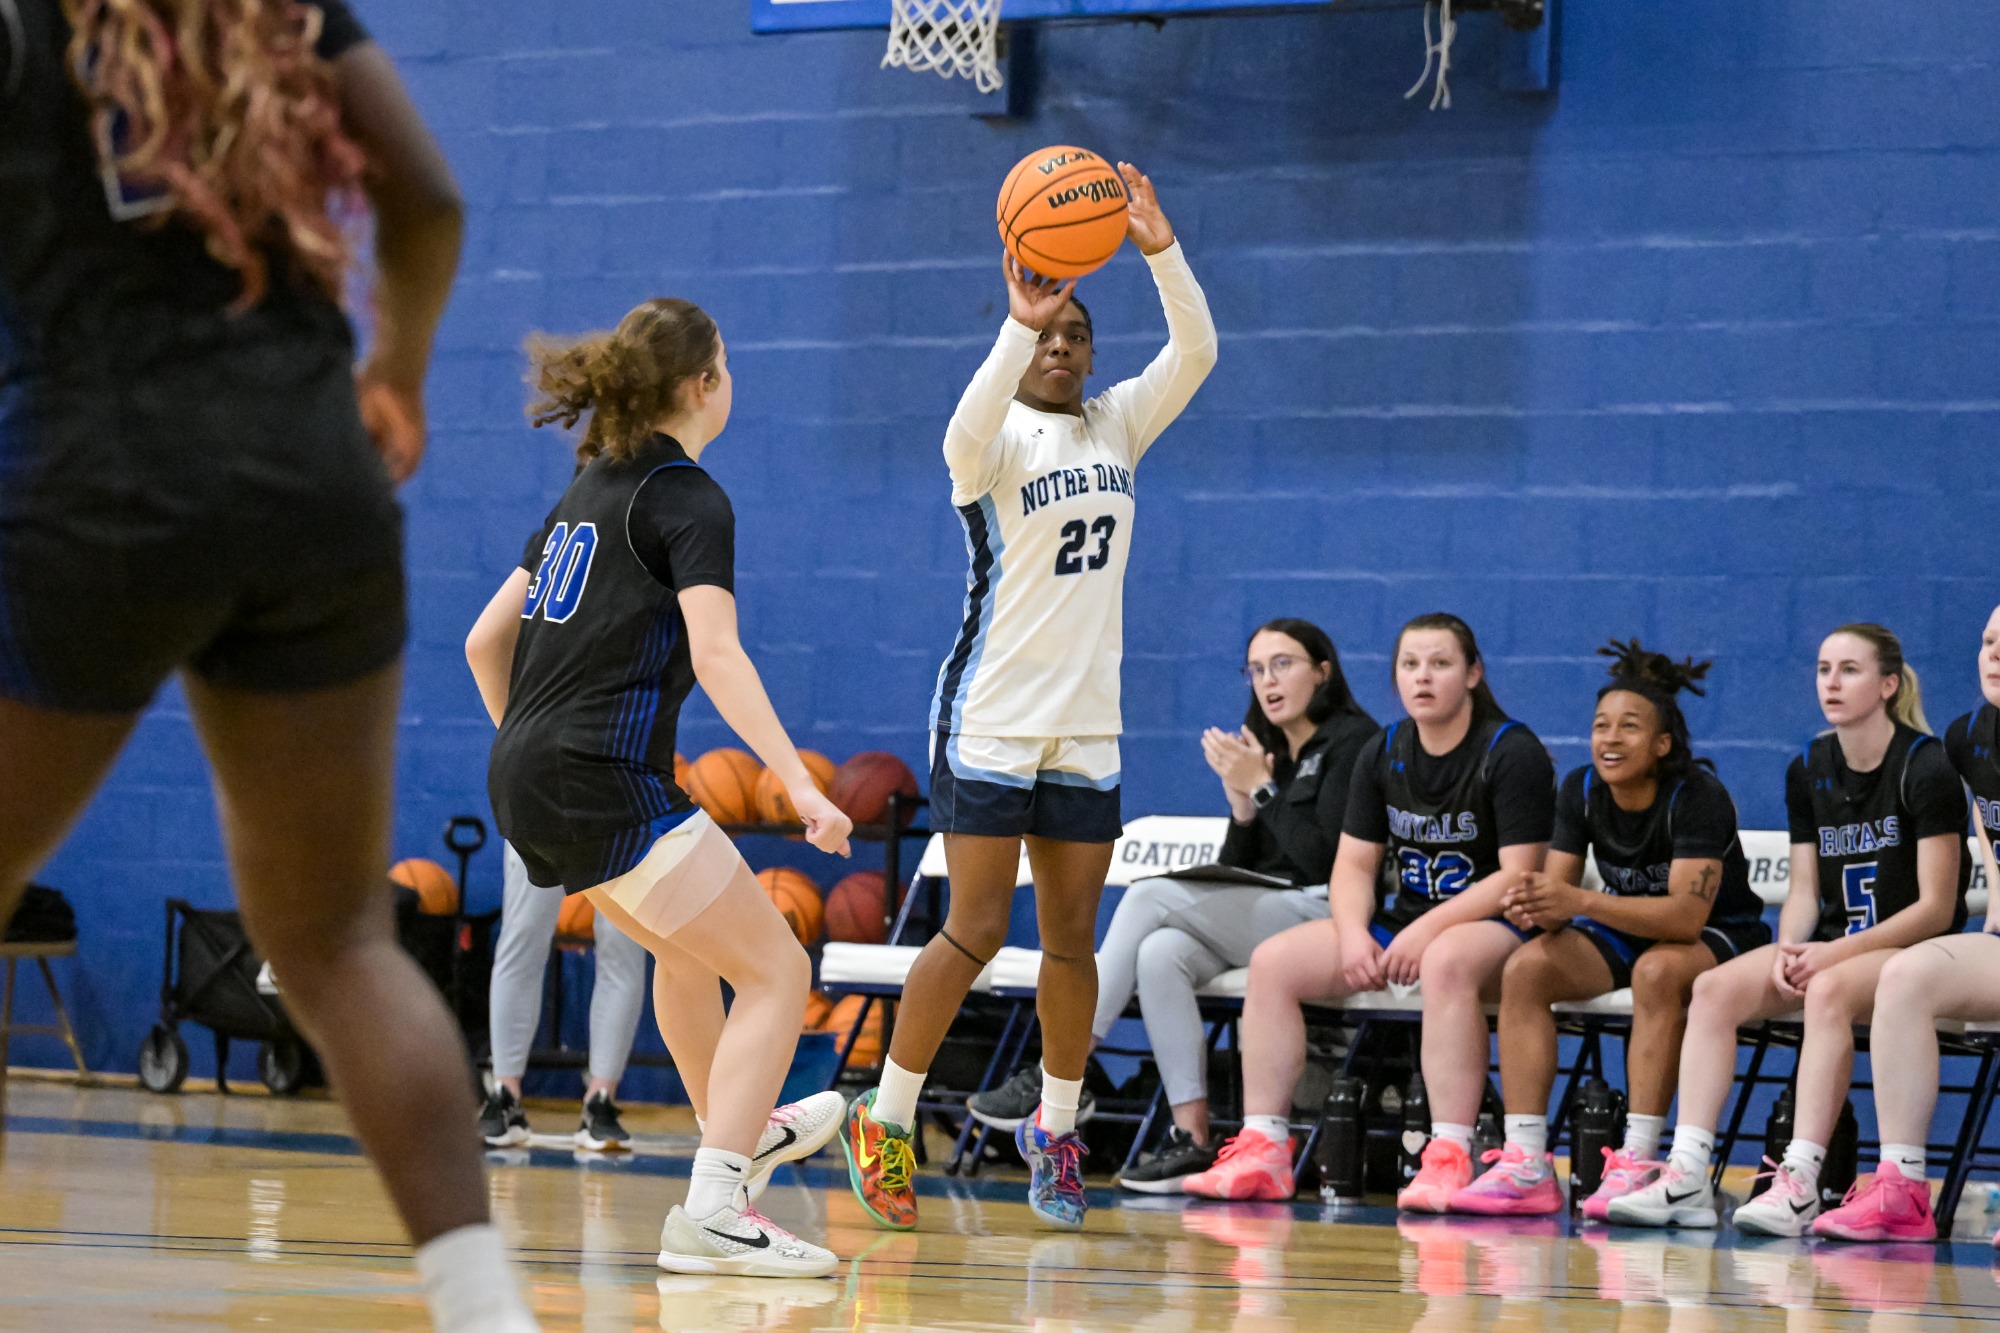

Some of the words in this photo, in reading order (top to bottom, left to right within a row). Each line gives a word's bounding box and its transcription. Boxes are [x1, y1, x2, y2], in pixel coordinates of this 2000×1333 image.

[1047, 178, 1123, 208] Wilson
[1020, 469, 1089, 517] NOTRE
[1054, 514, 1117, 576] 23
[520, 521, 599, 624] 30
[1386, 804, 1478, 843] ROYALS
[1121, 840, 1215, 867] GATOR
[1842, 861, 1879, 937] 5
